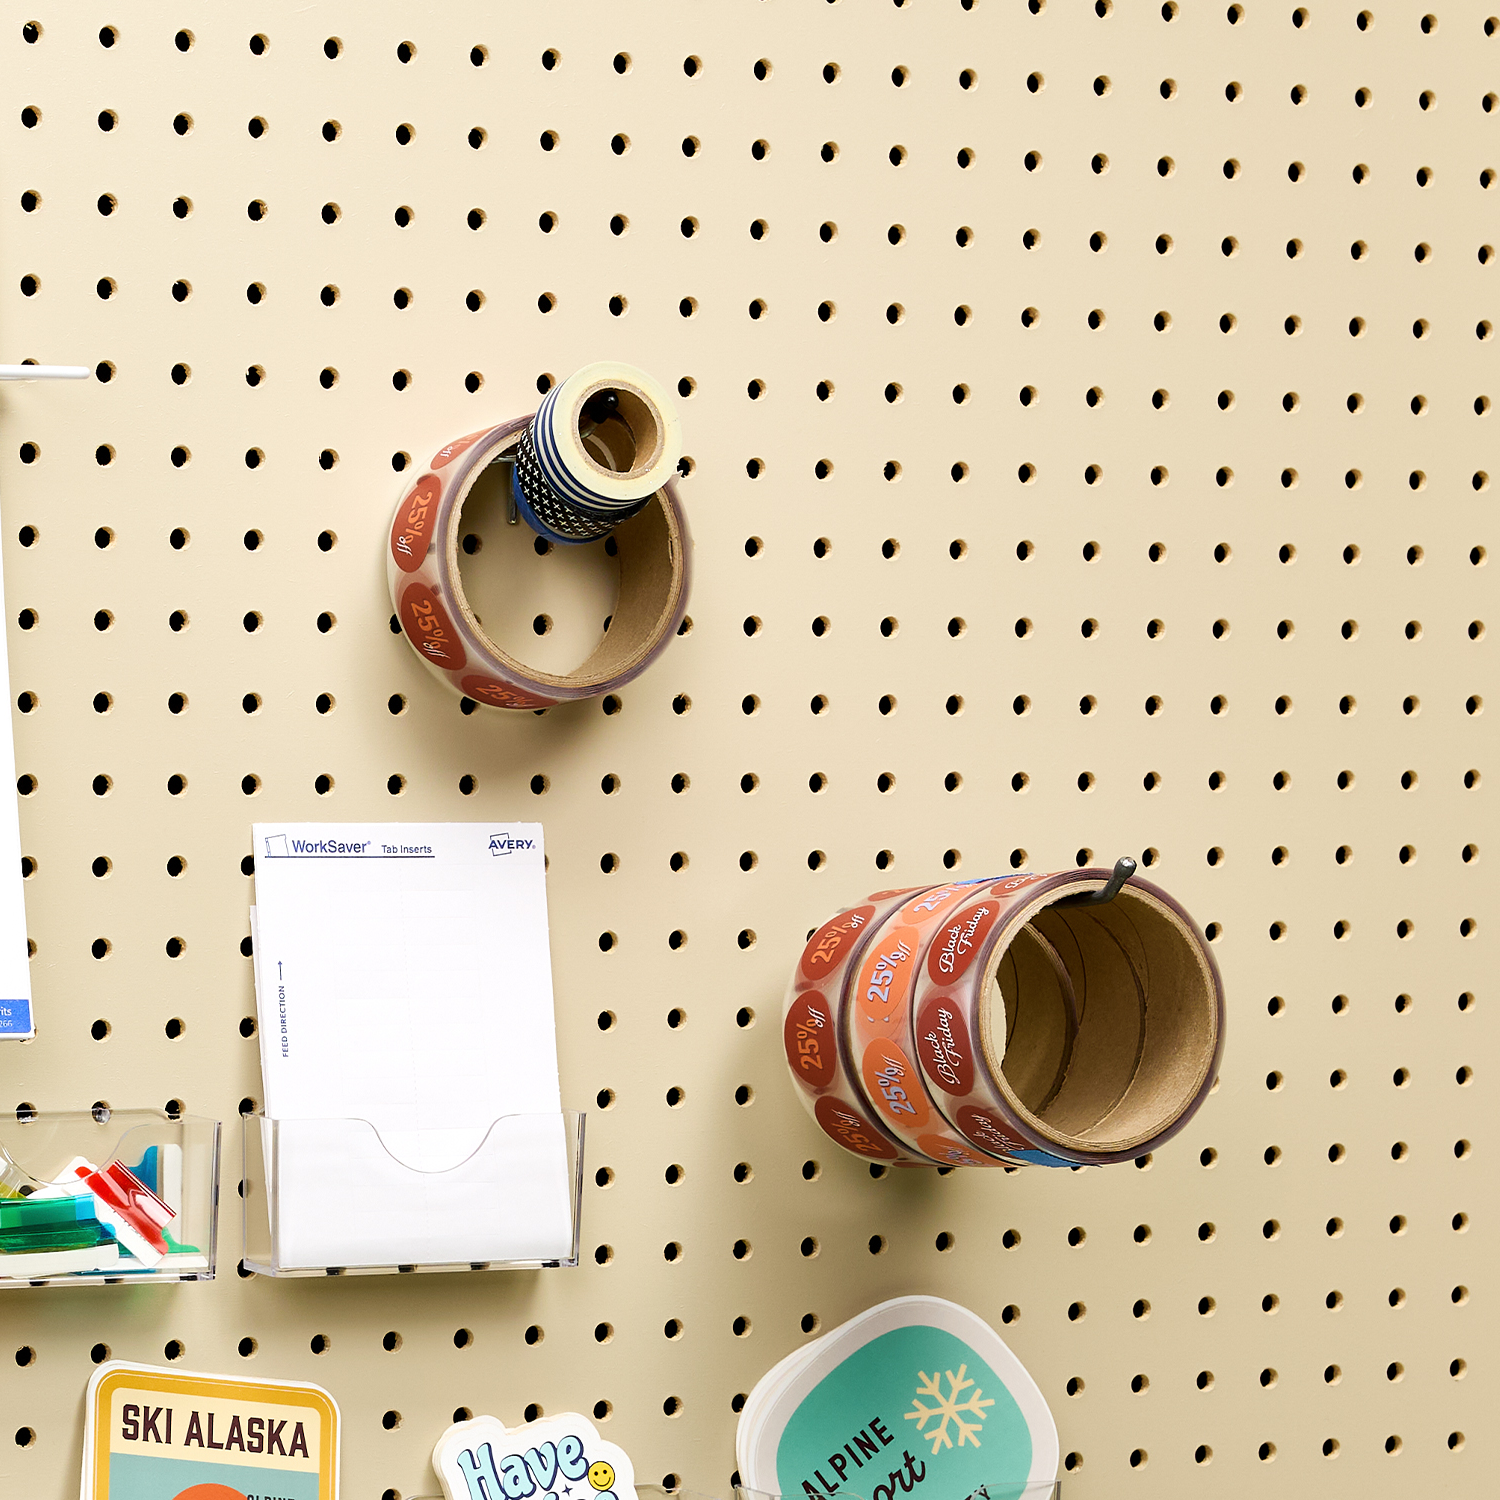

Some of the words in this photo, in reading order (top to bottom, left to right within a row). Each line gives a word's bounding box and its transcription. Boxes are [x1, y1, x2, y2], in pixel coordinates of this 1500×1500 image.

[405, 491, 433, 546] 25%
[396, 535, 414, 557] off
[411, 599, 449, 654] 25%
[422, 641, 451, 661] off
[381, 845, 398, 854] Tab
[400, 845, 432, 854] Inserts
[488, 839, 534, 850] AVERY
[810, 922, 855, 964] 25%
[850, 914, 865, 929] off
[938, 924, 962, 974] Black
[957, 905, 990, 955] Friday
[866, 951, 902, 1003] 25%
[897, 939, 912, 962] off
[278, 985, 288, 1034] DIRECTION
[807, 1004, 826, 1028] off
[281, 1035, 289, 1058] FEED
[797, 1017, 824, 1071] 25%
[923, 1030, 961, 1086] Black
[938, 1006, 964, 1067] Friday
[881, 1053, 906, 1077] off
[874, 1068, 917, 1116] 25%
[830, 1116, 882, 1152] 25%
[831, 1108, 861, 1128] off
[121, 1404, 173, 1445] SKI
[183, 1410, 310, 1459] ALASKA
[457, 1435, 589, 1500] Have
[801, 1416, 895, 1500] ALPINE
